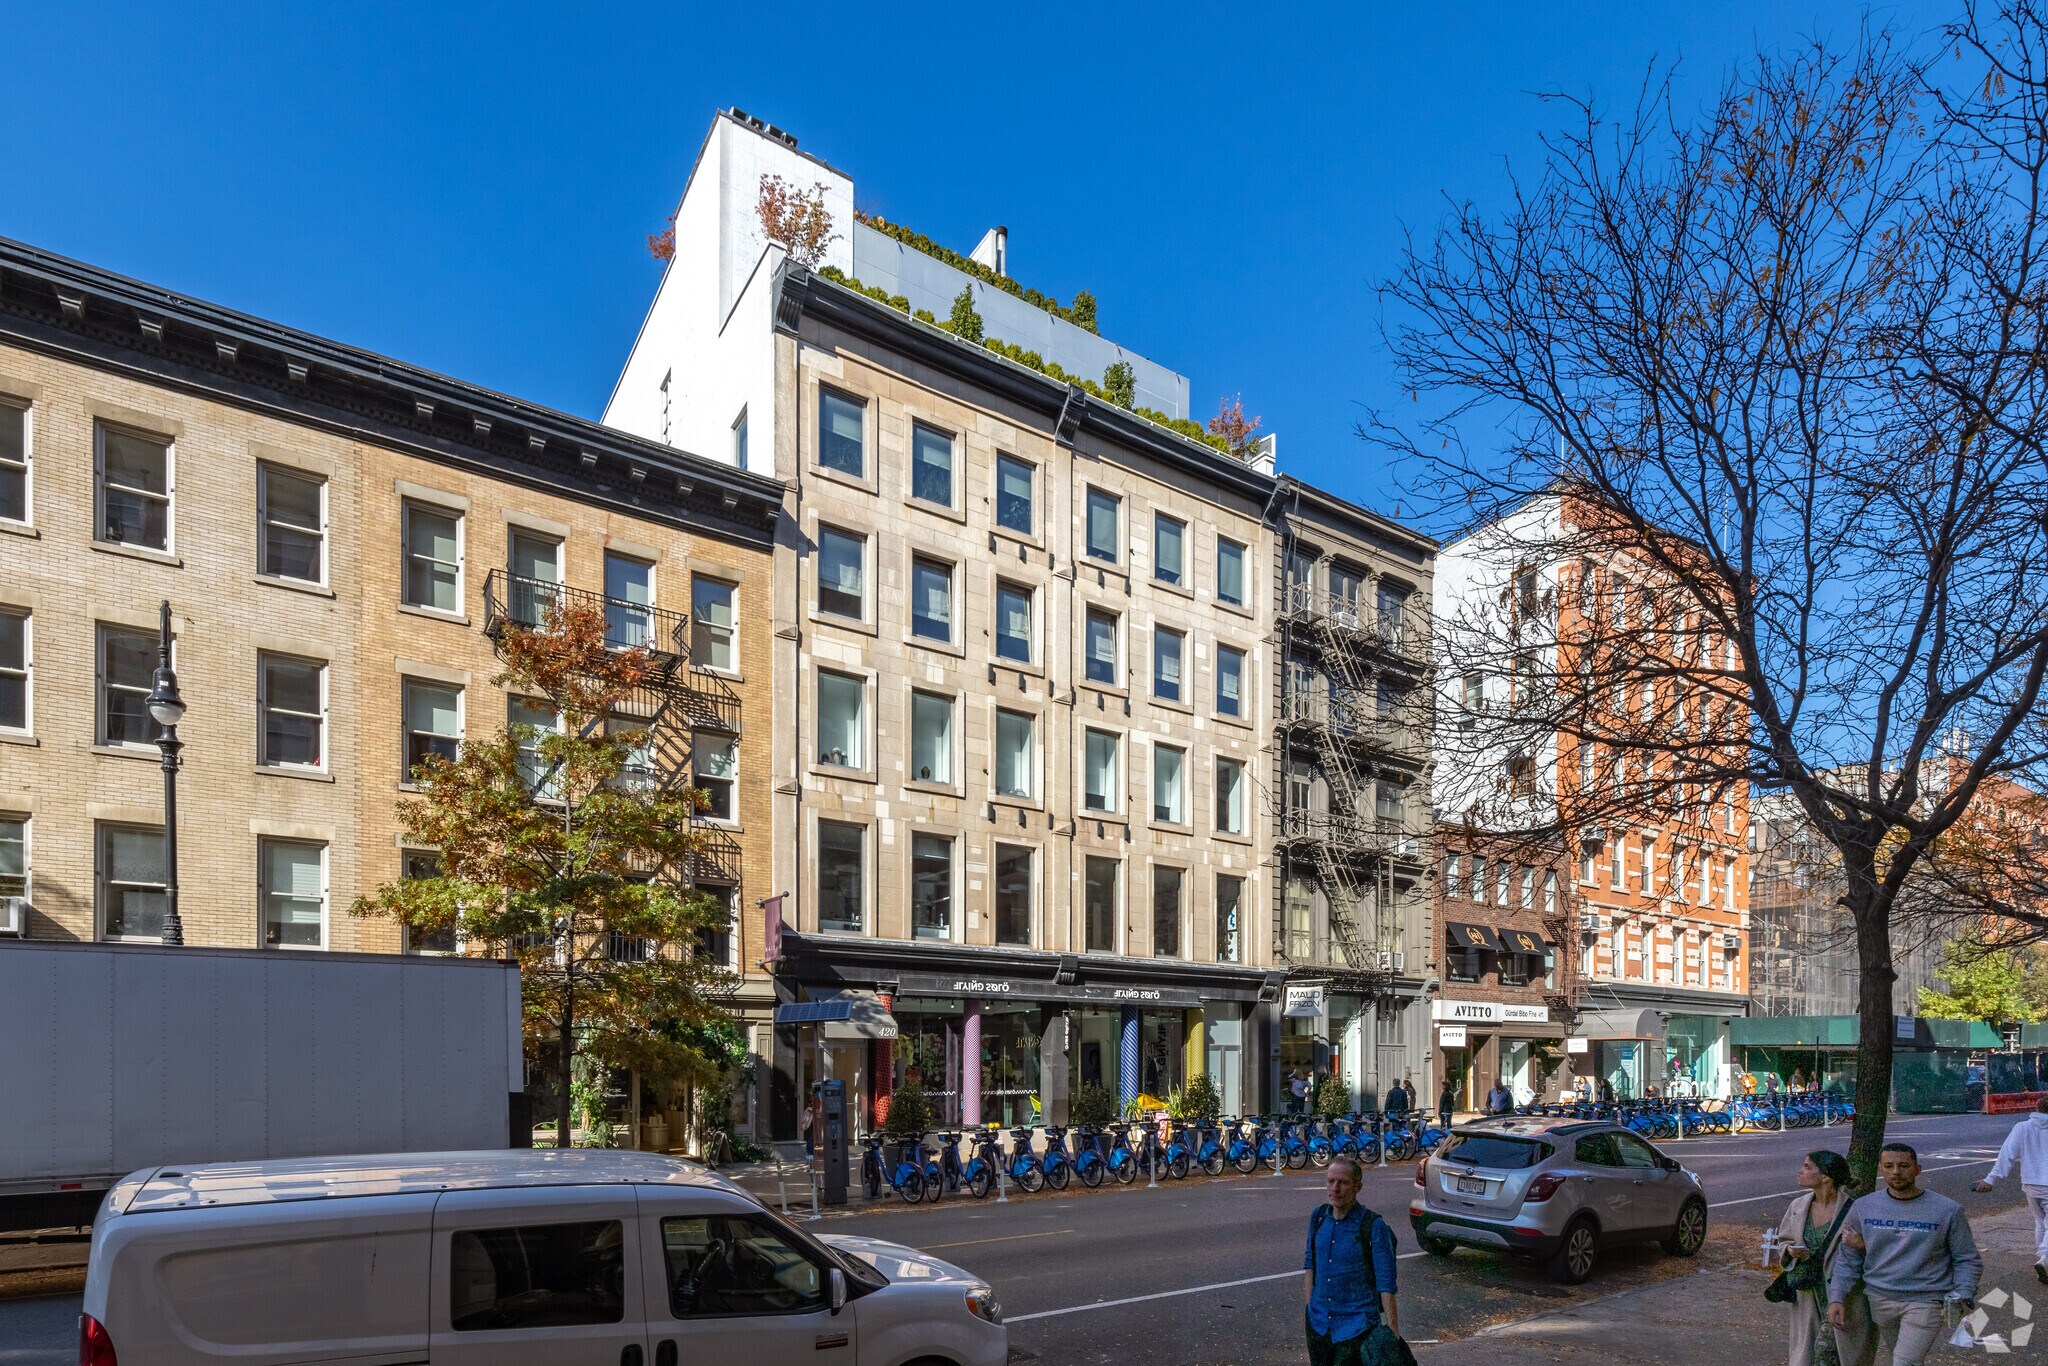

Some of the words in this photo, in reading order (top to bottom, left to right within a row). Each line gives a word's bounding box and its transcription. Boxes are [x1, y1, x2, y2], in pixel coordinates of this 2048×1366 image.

[1455, 1006, 1492, 1017] AVITTO
[879, 1027, 896, 1037] 420
[1864, 1218, 1894, 1227] POLO
[1898, 1220, 1940, 1231] SPORT
